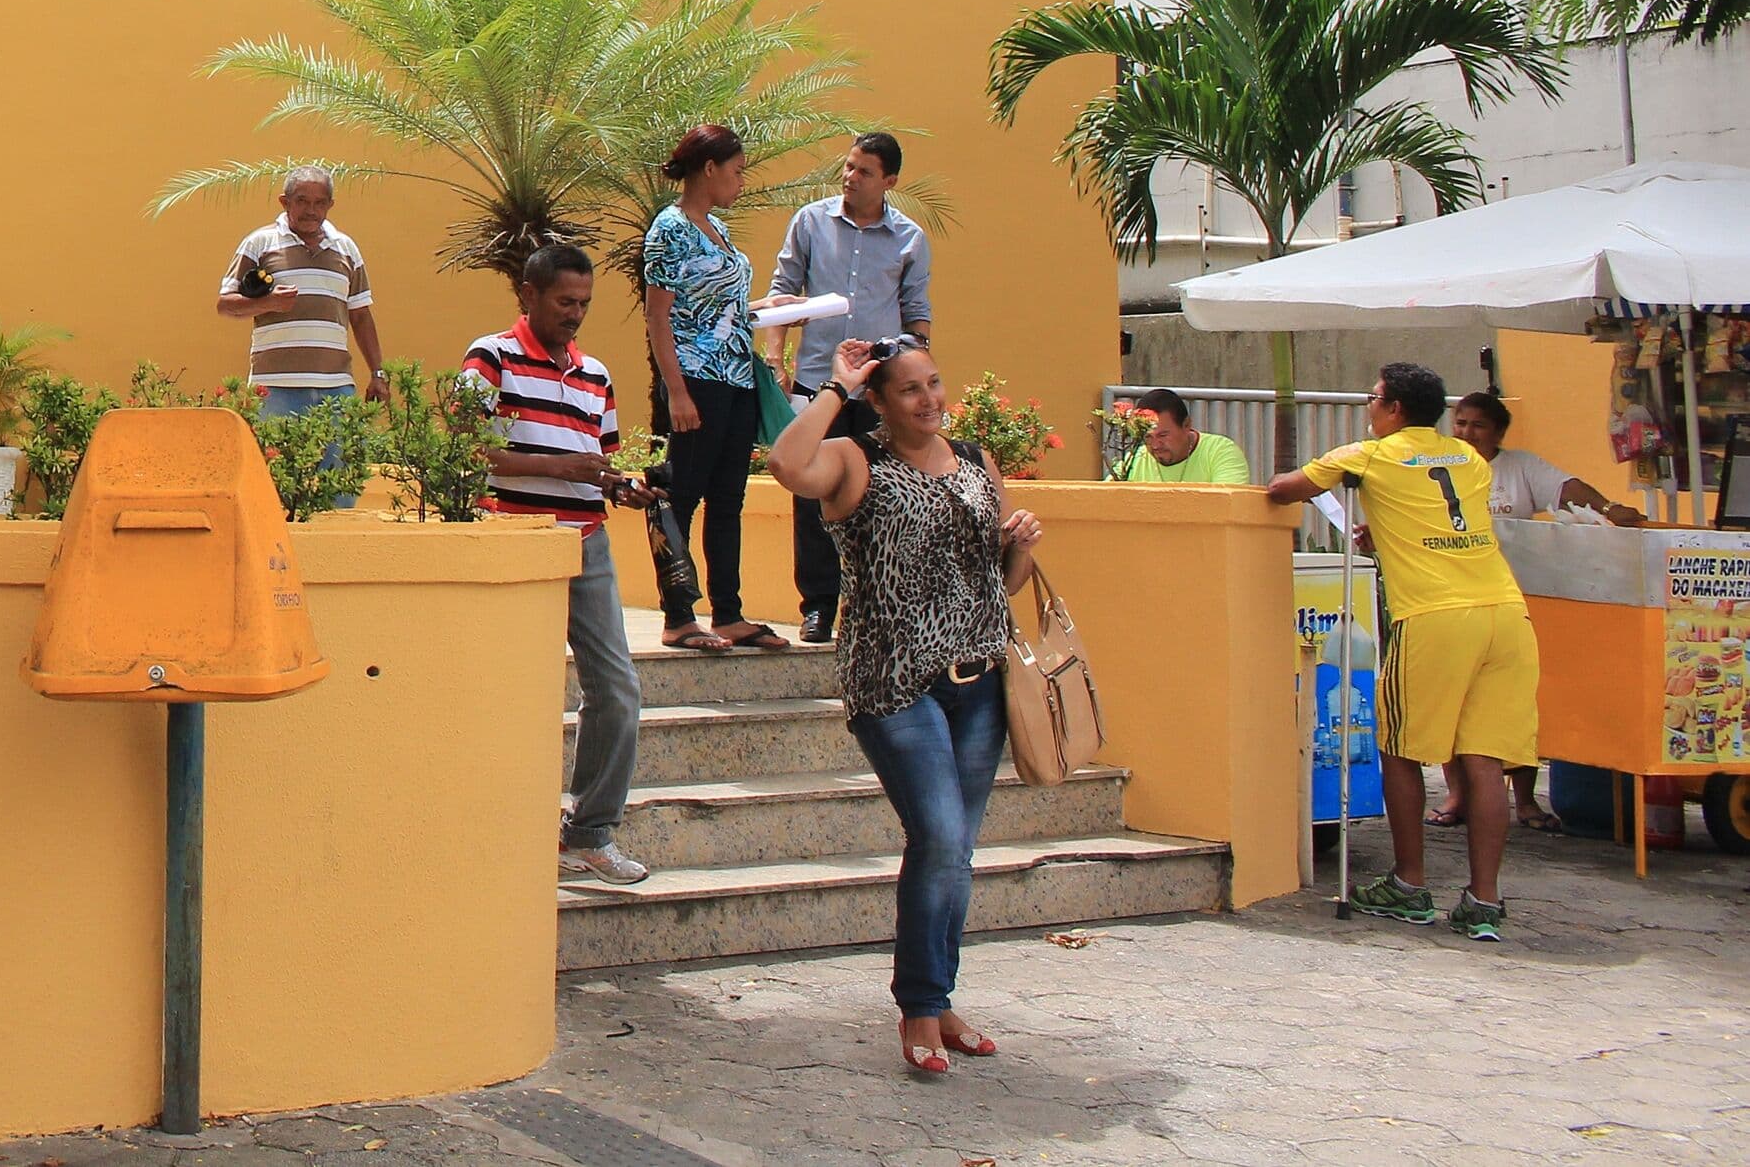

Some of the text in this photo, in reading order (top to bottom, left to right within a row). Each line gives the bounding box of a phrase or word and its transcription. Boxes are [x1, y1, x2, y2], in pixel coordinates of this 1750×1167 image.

[1427, 466, 1467, 531] 1
[1422, 537, 1470, 550] FERNANDO
[1669, 556, 1717, 575] LANCHE
[1672, 578, 1690, 596] DO
